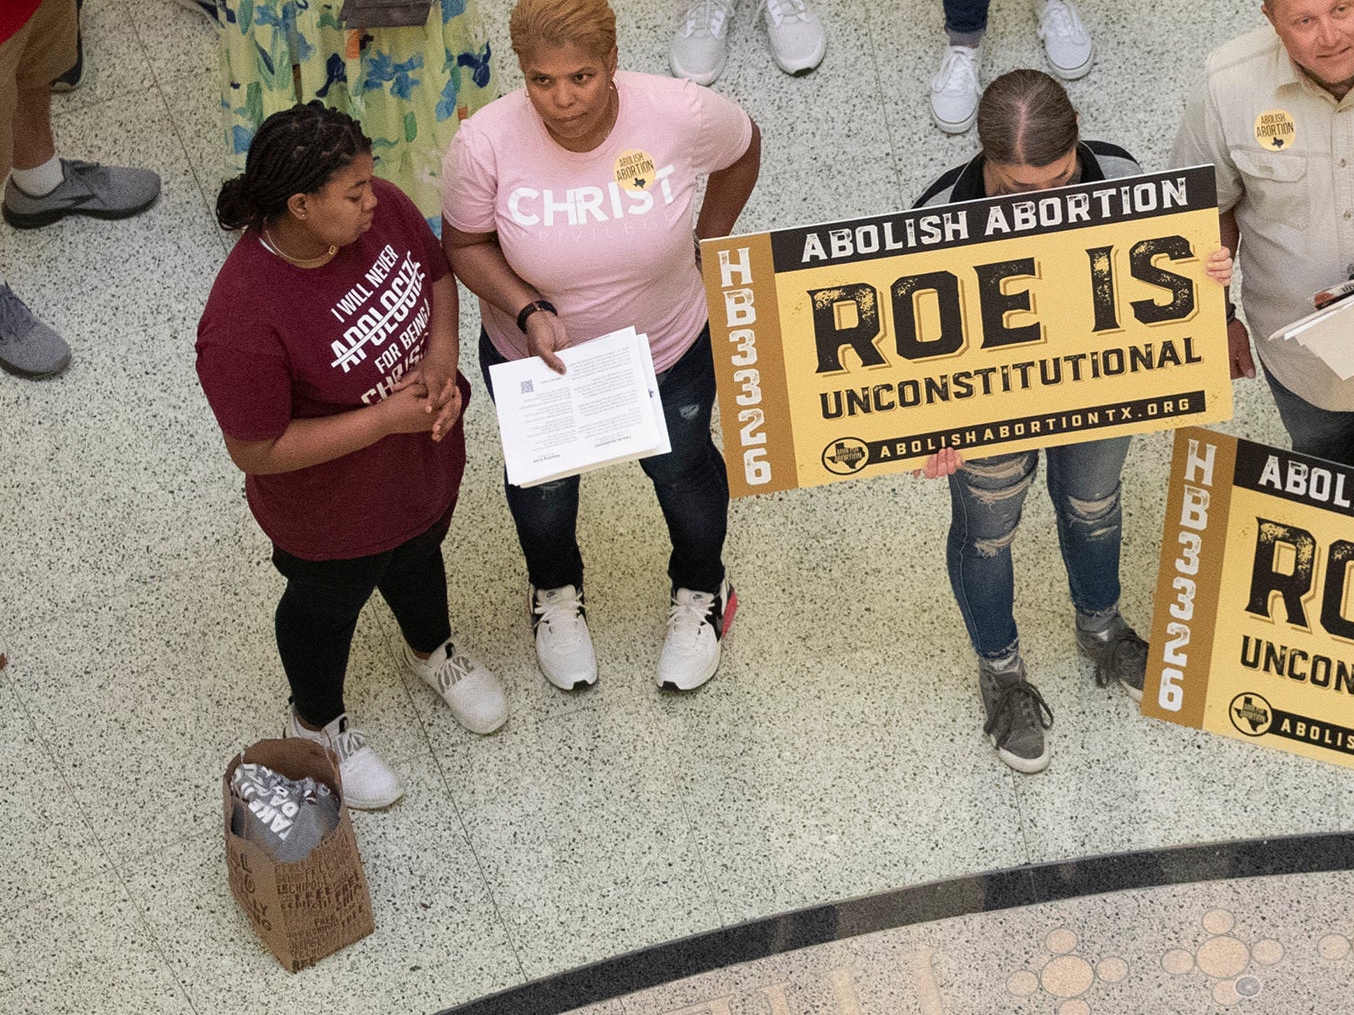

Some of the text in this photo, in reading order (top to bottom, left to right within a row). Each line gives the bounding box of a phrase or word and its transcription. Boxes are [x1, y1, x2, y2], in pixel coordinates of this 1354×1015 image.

[1256, 122, 1295, 138] ABORTION
[1260, 113, 1286, 125] ABOLISH
[616, 159, 655, 183] ABORTION
[619, 152, 645, 167] ABOLISH
[507, 164, 675, 227] CHRIST
[801, 177, 1190, 265] ABOLISH ABORTION
[336, 283, 374, 316] WILL
[364, 244, 399, 288] NEVER
[805, 234, 1202, 377] ROE IS
[374, 342, 402, 374] FOR
[819, 336, 1203, 422] UNCONSTITUTIONAL
[879, 397, 1191, 460] ABOLISHABORTIONTX.ORG
